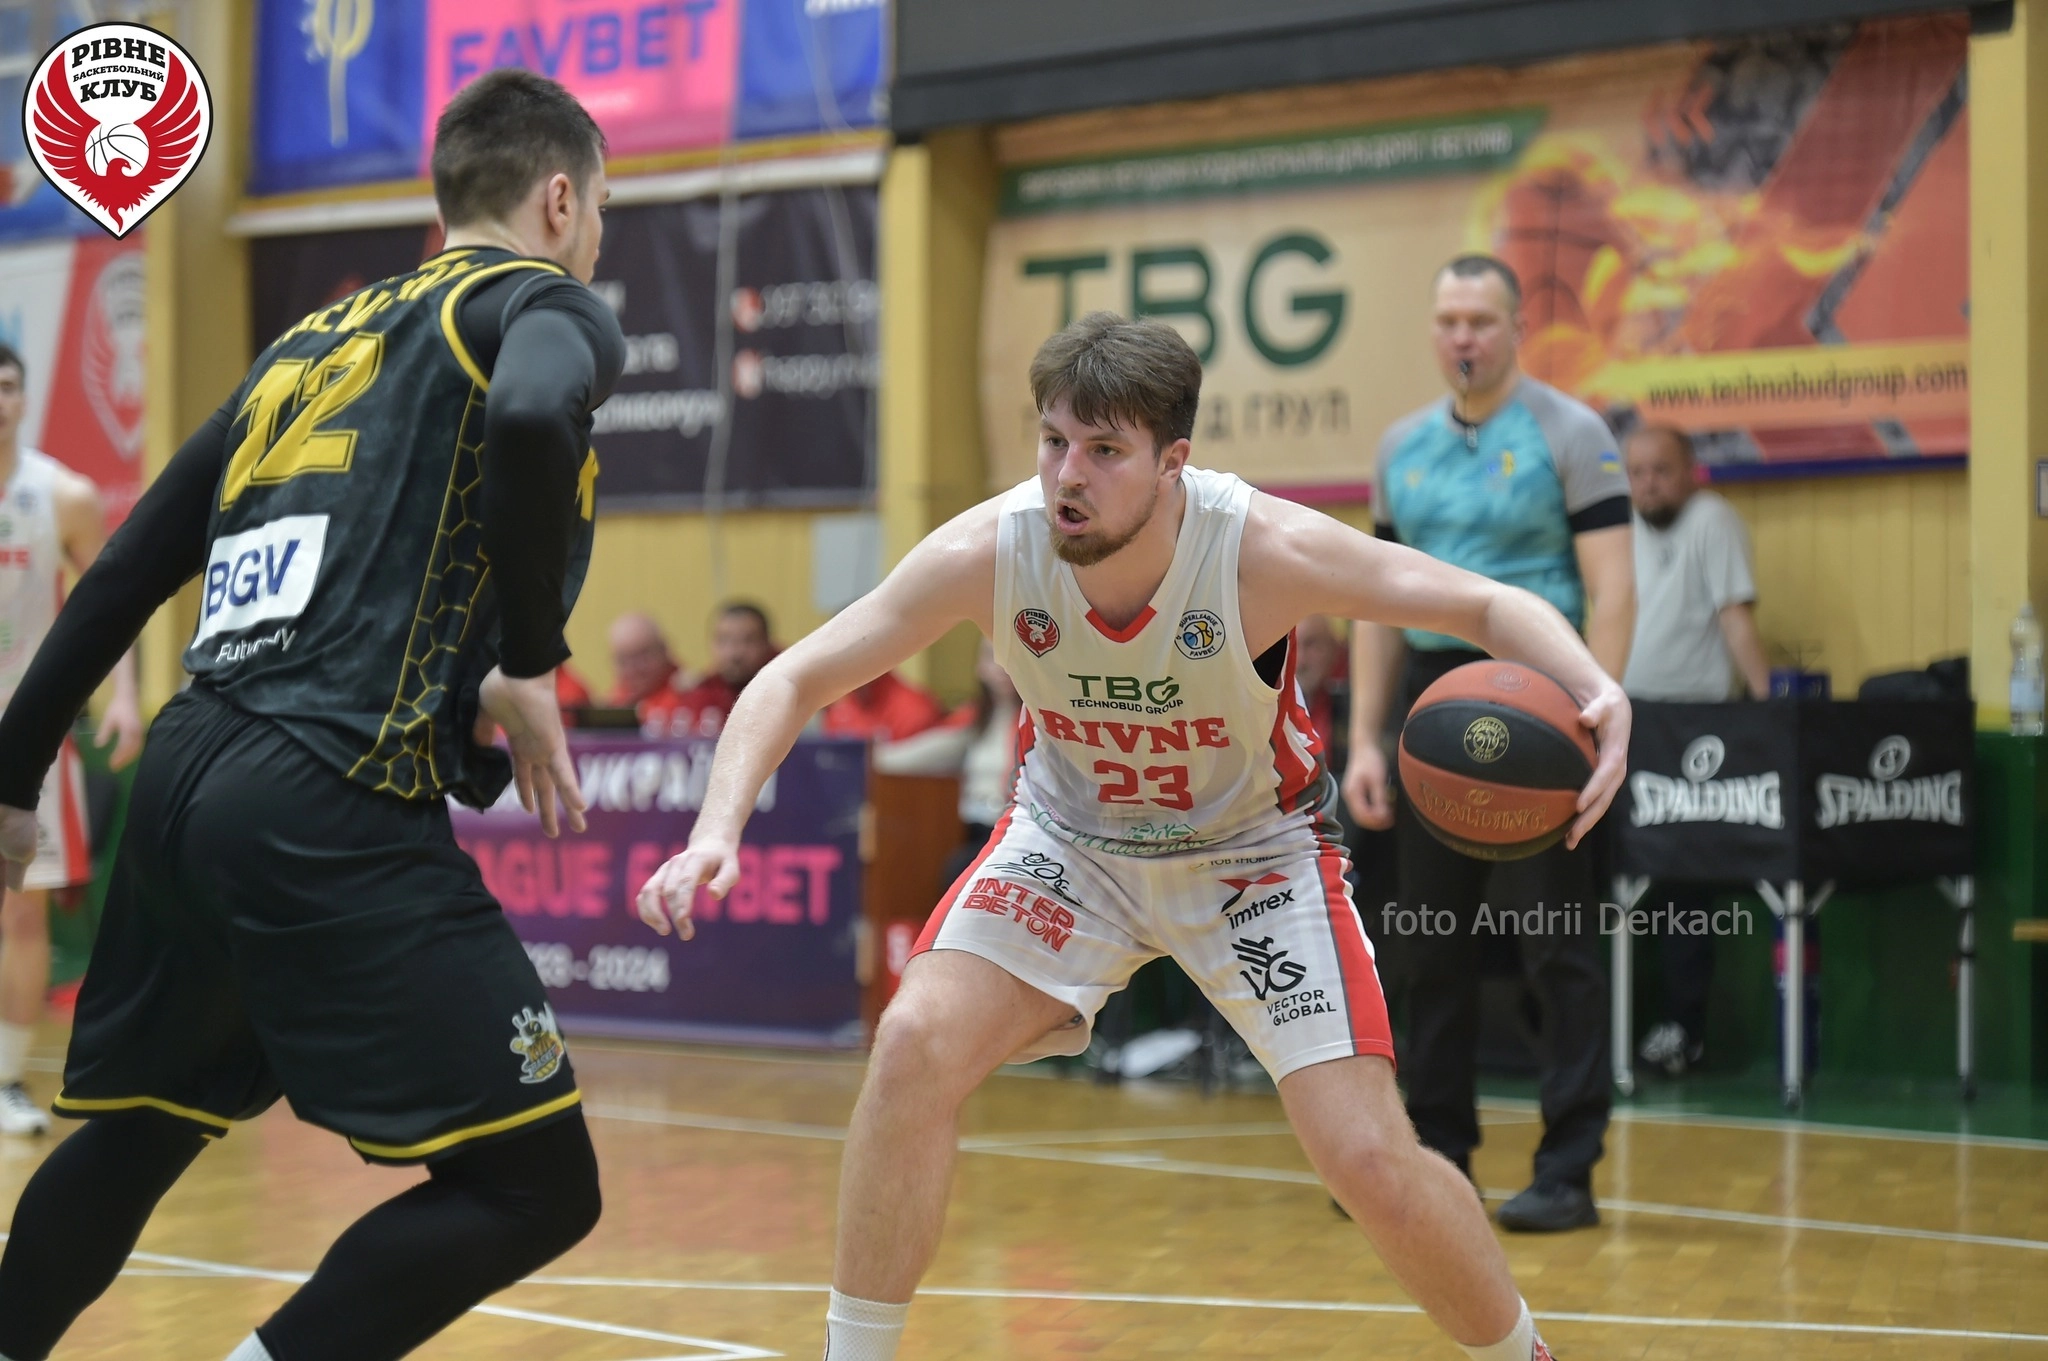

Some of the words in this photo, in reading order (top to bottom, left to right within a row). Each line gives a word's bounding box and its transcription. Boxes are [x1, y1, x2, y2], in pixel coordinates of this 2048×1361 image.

[1023, 233, 1347, 367] TBG
[1648, 361, 1968, 410] www.technobudgroup.com
[219, 331, 386, 511] 12
[205, 539, 301, 621] BGV
[1068, 673, 1180, 706] TBG
[1070, 699, 1143, 713] TECHNOBUD
[1145, 699, 1184, 715] GROUP
[1038, 708, 1230, 755] RIVNE
[1093, 759, 1194, 811] 23
[1630, 770, 1784, 830] SPALDING
[1815, 770, 1964, 830] SPALDING
[962, 894, 1073, 952] BETON
[970, 878, 1075, 934] INTER
[1225, 888, 1295, 930] imtrex
[1267, 989, 1325, 1015] VECTOR
[1273, 1001, 1337, 1026] GLOBAL
